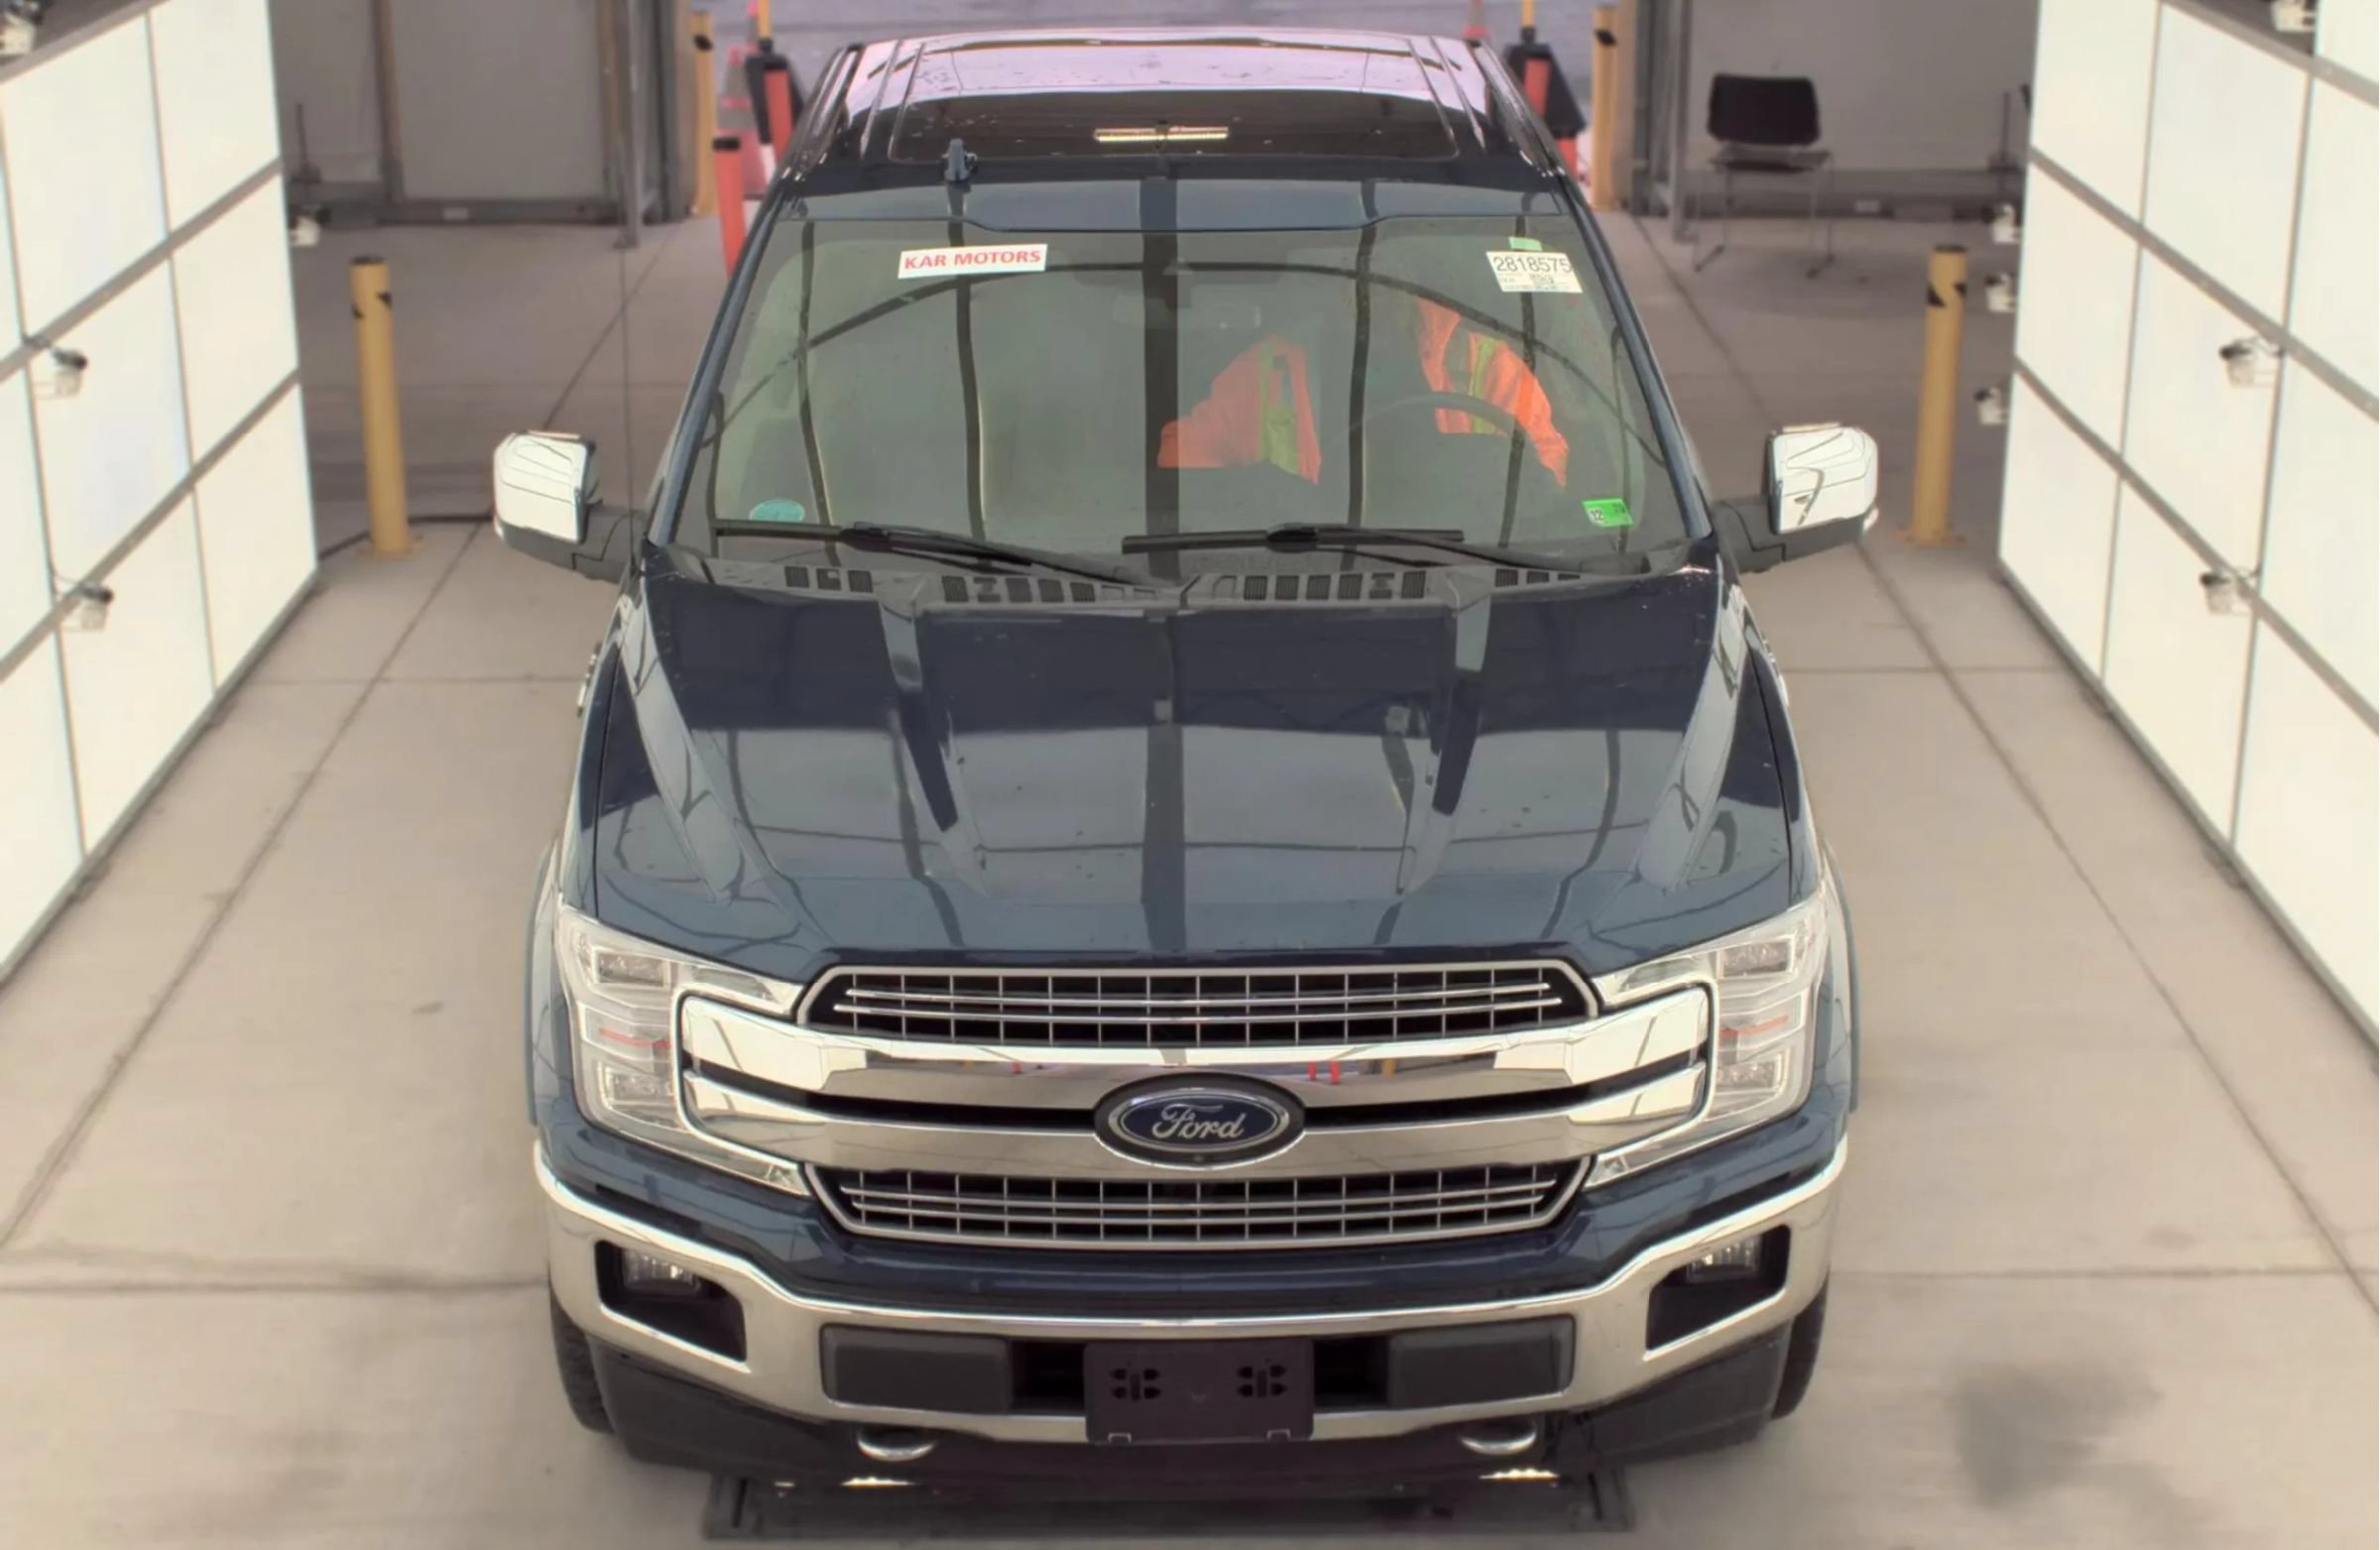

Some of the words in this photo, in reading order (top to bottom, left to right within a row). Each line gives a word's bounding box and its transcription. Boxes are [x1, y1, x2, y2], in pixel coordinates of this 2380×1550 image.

[904, 255, 946, 270] KAR
[954, 250, 1041, 266] MOTORS
[1493, 256, 1572, 274] 2818575
[1151, 1103, 1247, 1139] Ford
